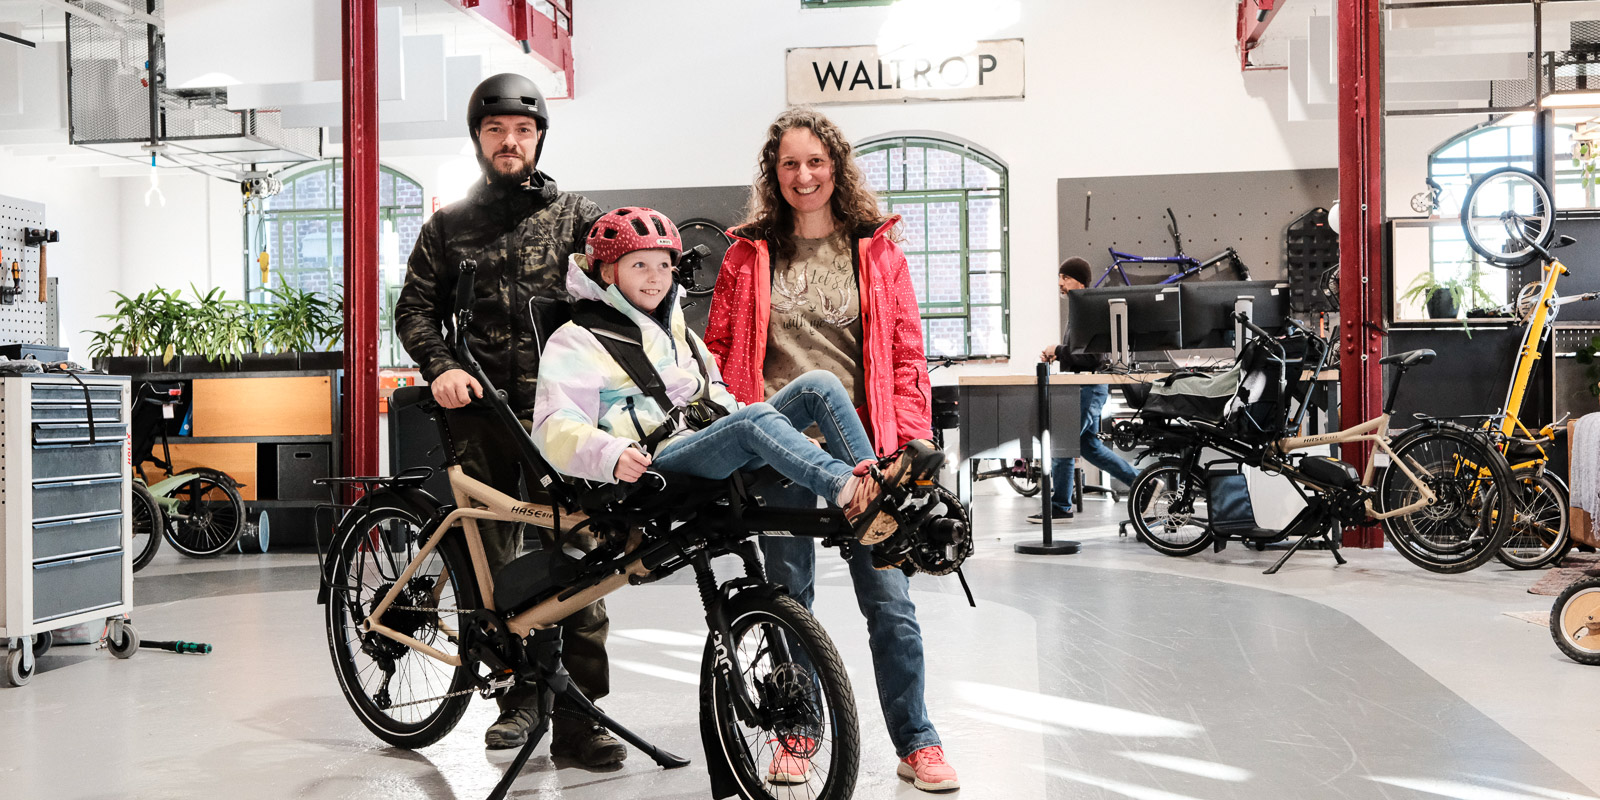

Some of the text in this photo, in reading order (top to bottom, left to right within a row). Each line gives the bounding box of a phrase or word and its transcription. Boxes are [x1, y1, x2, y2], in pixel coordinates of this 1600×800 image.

[810, 269, 842, 290] Let's
[783, 314, 806, 330] with
[511, 506, 542, 518] HASE
